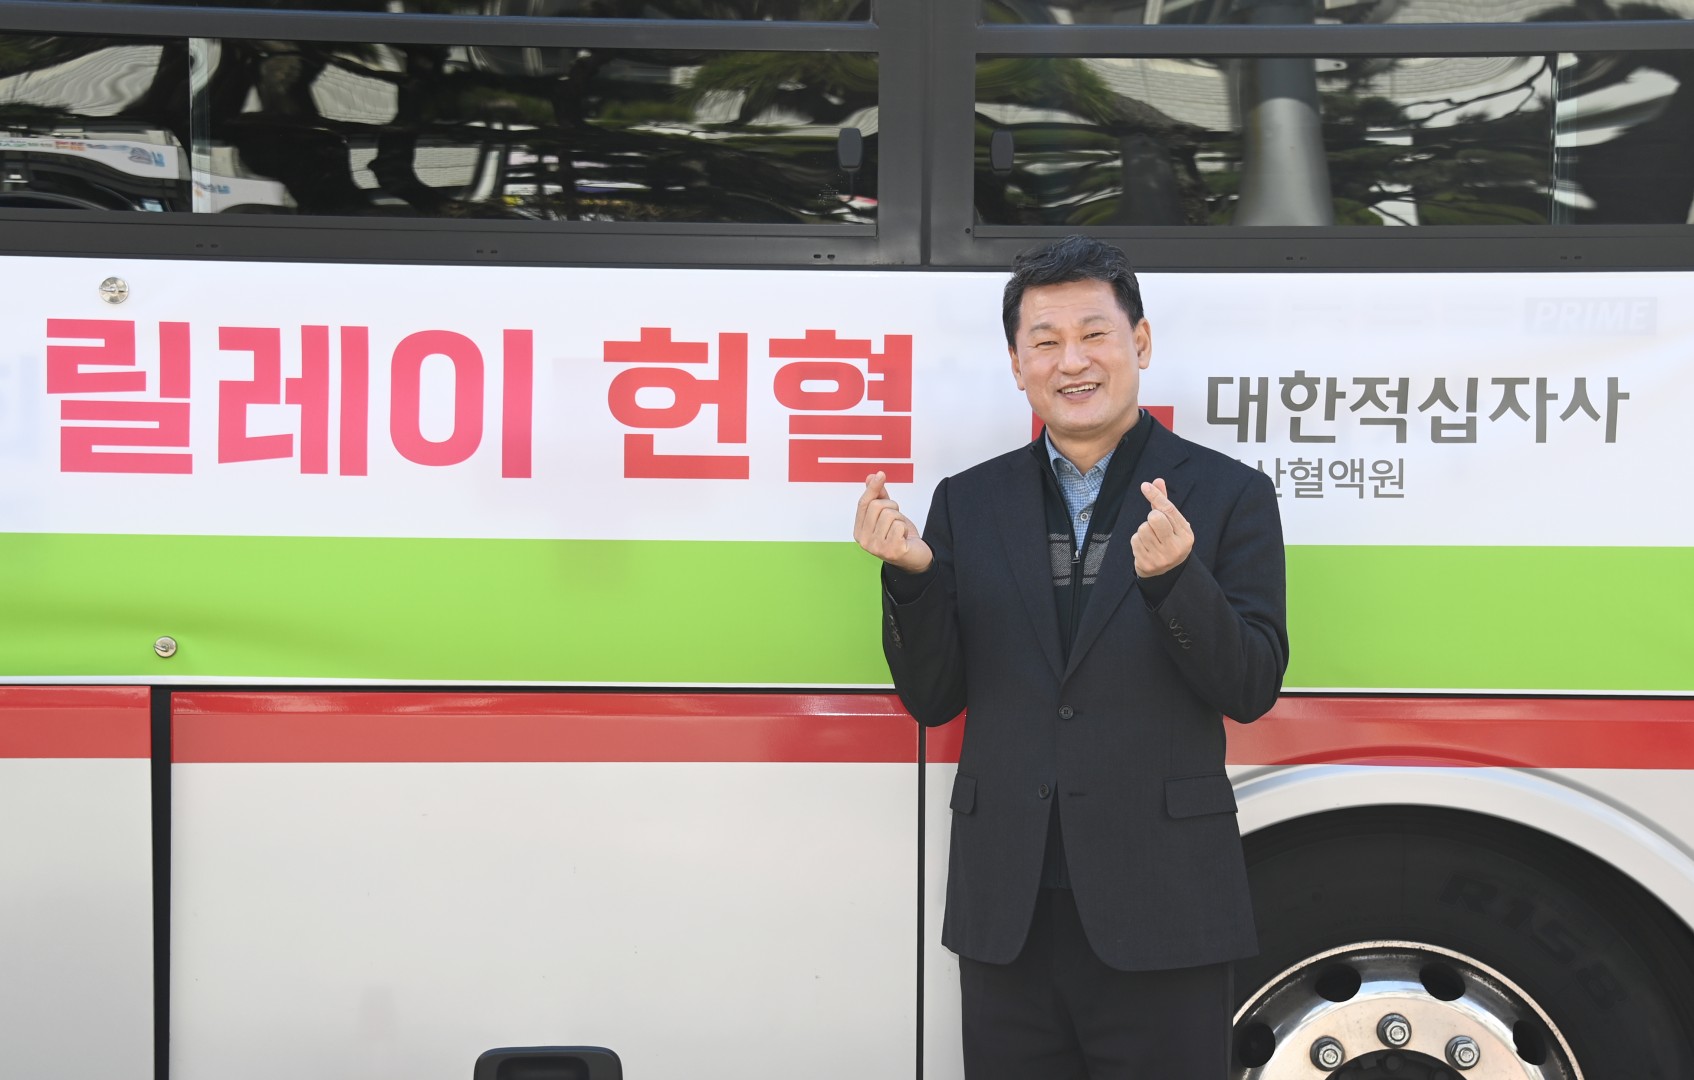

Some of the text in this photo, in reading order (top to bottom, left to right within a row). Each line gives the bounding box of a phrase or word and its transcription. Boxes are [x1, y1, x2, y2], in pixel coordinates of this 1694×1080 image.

[1533, 300, 1650, 331] PRIME
[47, 318, 533, 478] 릴레이
[603, 327, 914, 484] 헌혈
[1206, 370, 1630, 444] 대한적십자사
